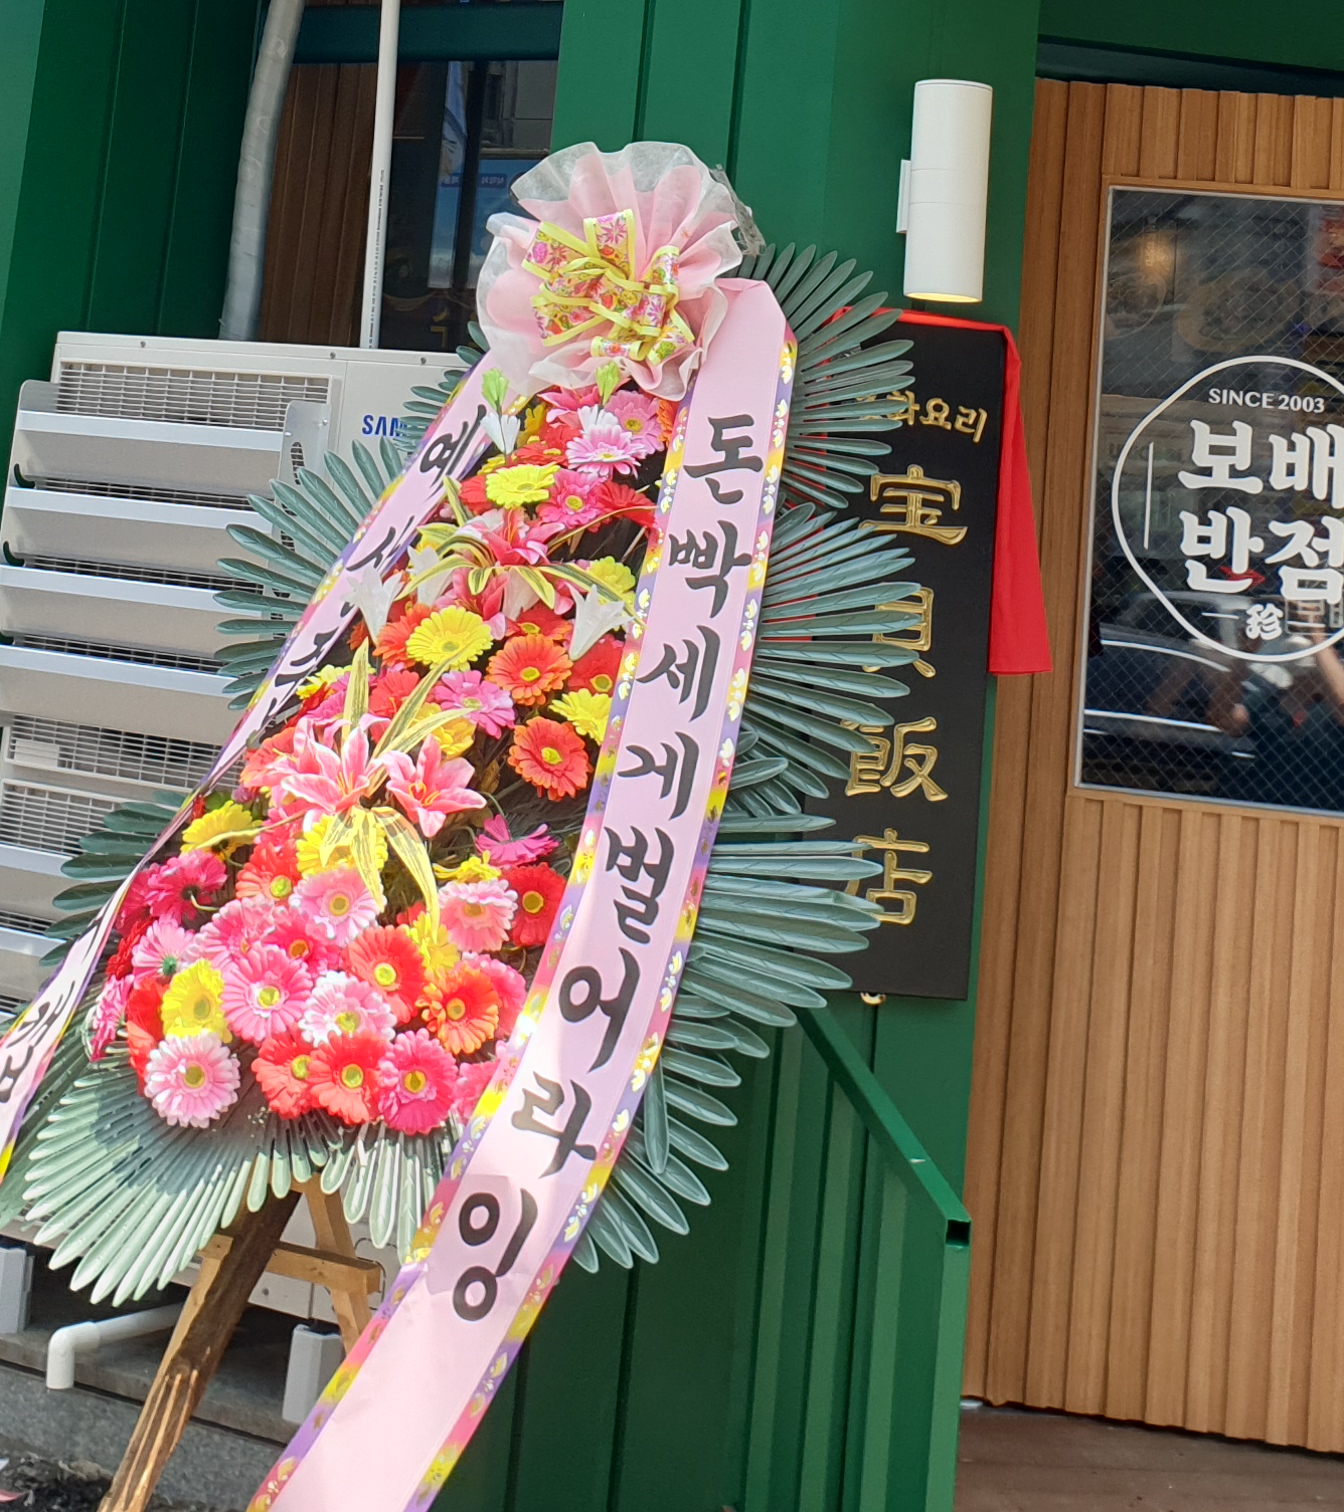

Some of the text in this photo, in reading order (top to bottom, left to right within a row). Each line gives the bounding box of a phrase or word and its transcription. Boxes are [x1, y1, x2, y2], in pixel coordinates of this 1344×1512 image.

[854, 390, 988, 444] 화요리
[1208, 388, 1325, 414] SINCE 2003
